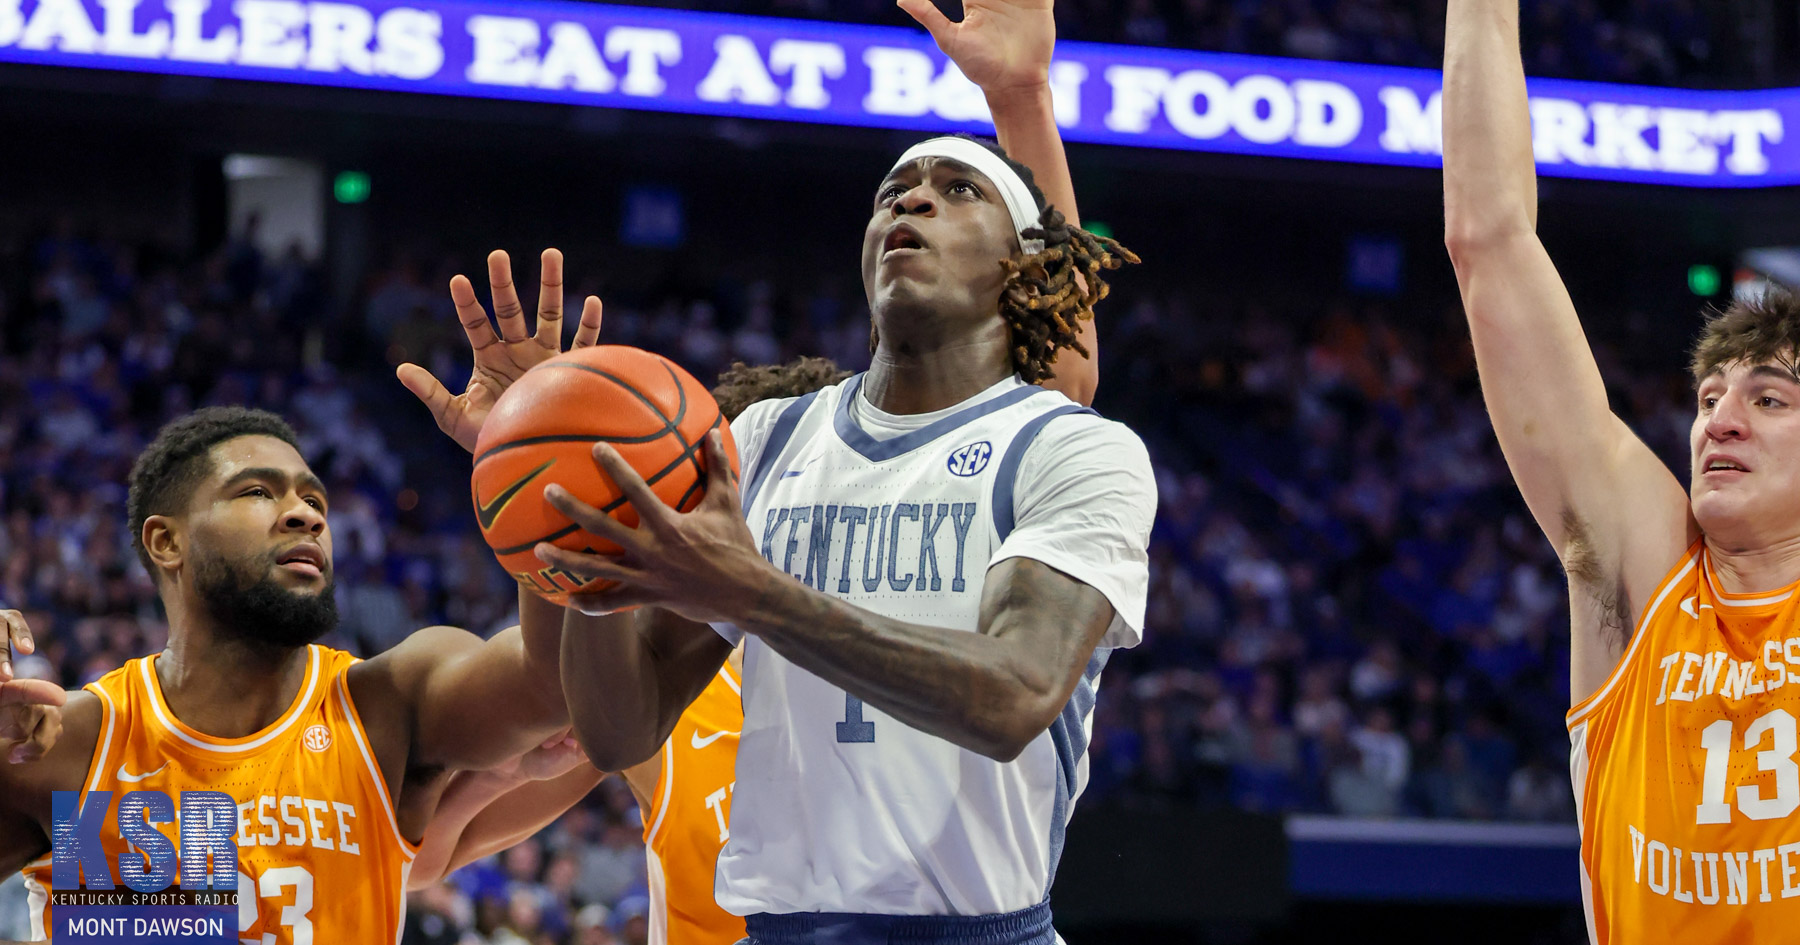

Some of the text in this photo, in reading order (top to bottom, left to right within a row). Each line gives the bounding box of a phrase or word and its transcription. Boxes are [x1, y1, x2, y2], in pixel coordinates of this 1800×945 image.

[466, 15, 681, 97] EAT
[697, 34, 846, 110] AT
[1104, 64, 1363, 148] FOOD
[1378, 85, 1784, 175] MRKET
[949, 442, 990, 476] SEC
[762, 502, 976, 593] KENTUCKY
[304, 727, 331, 750] SEC
[1696, 708, 1800, 825] 13
[1629, 825, 1800, 905] VOLUNTE
